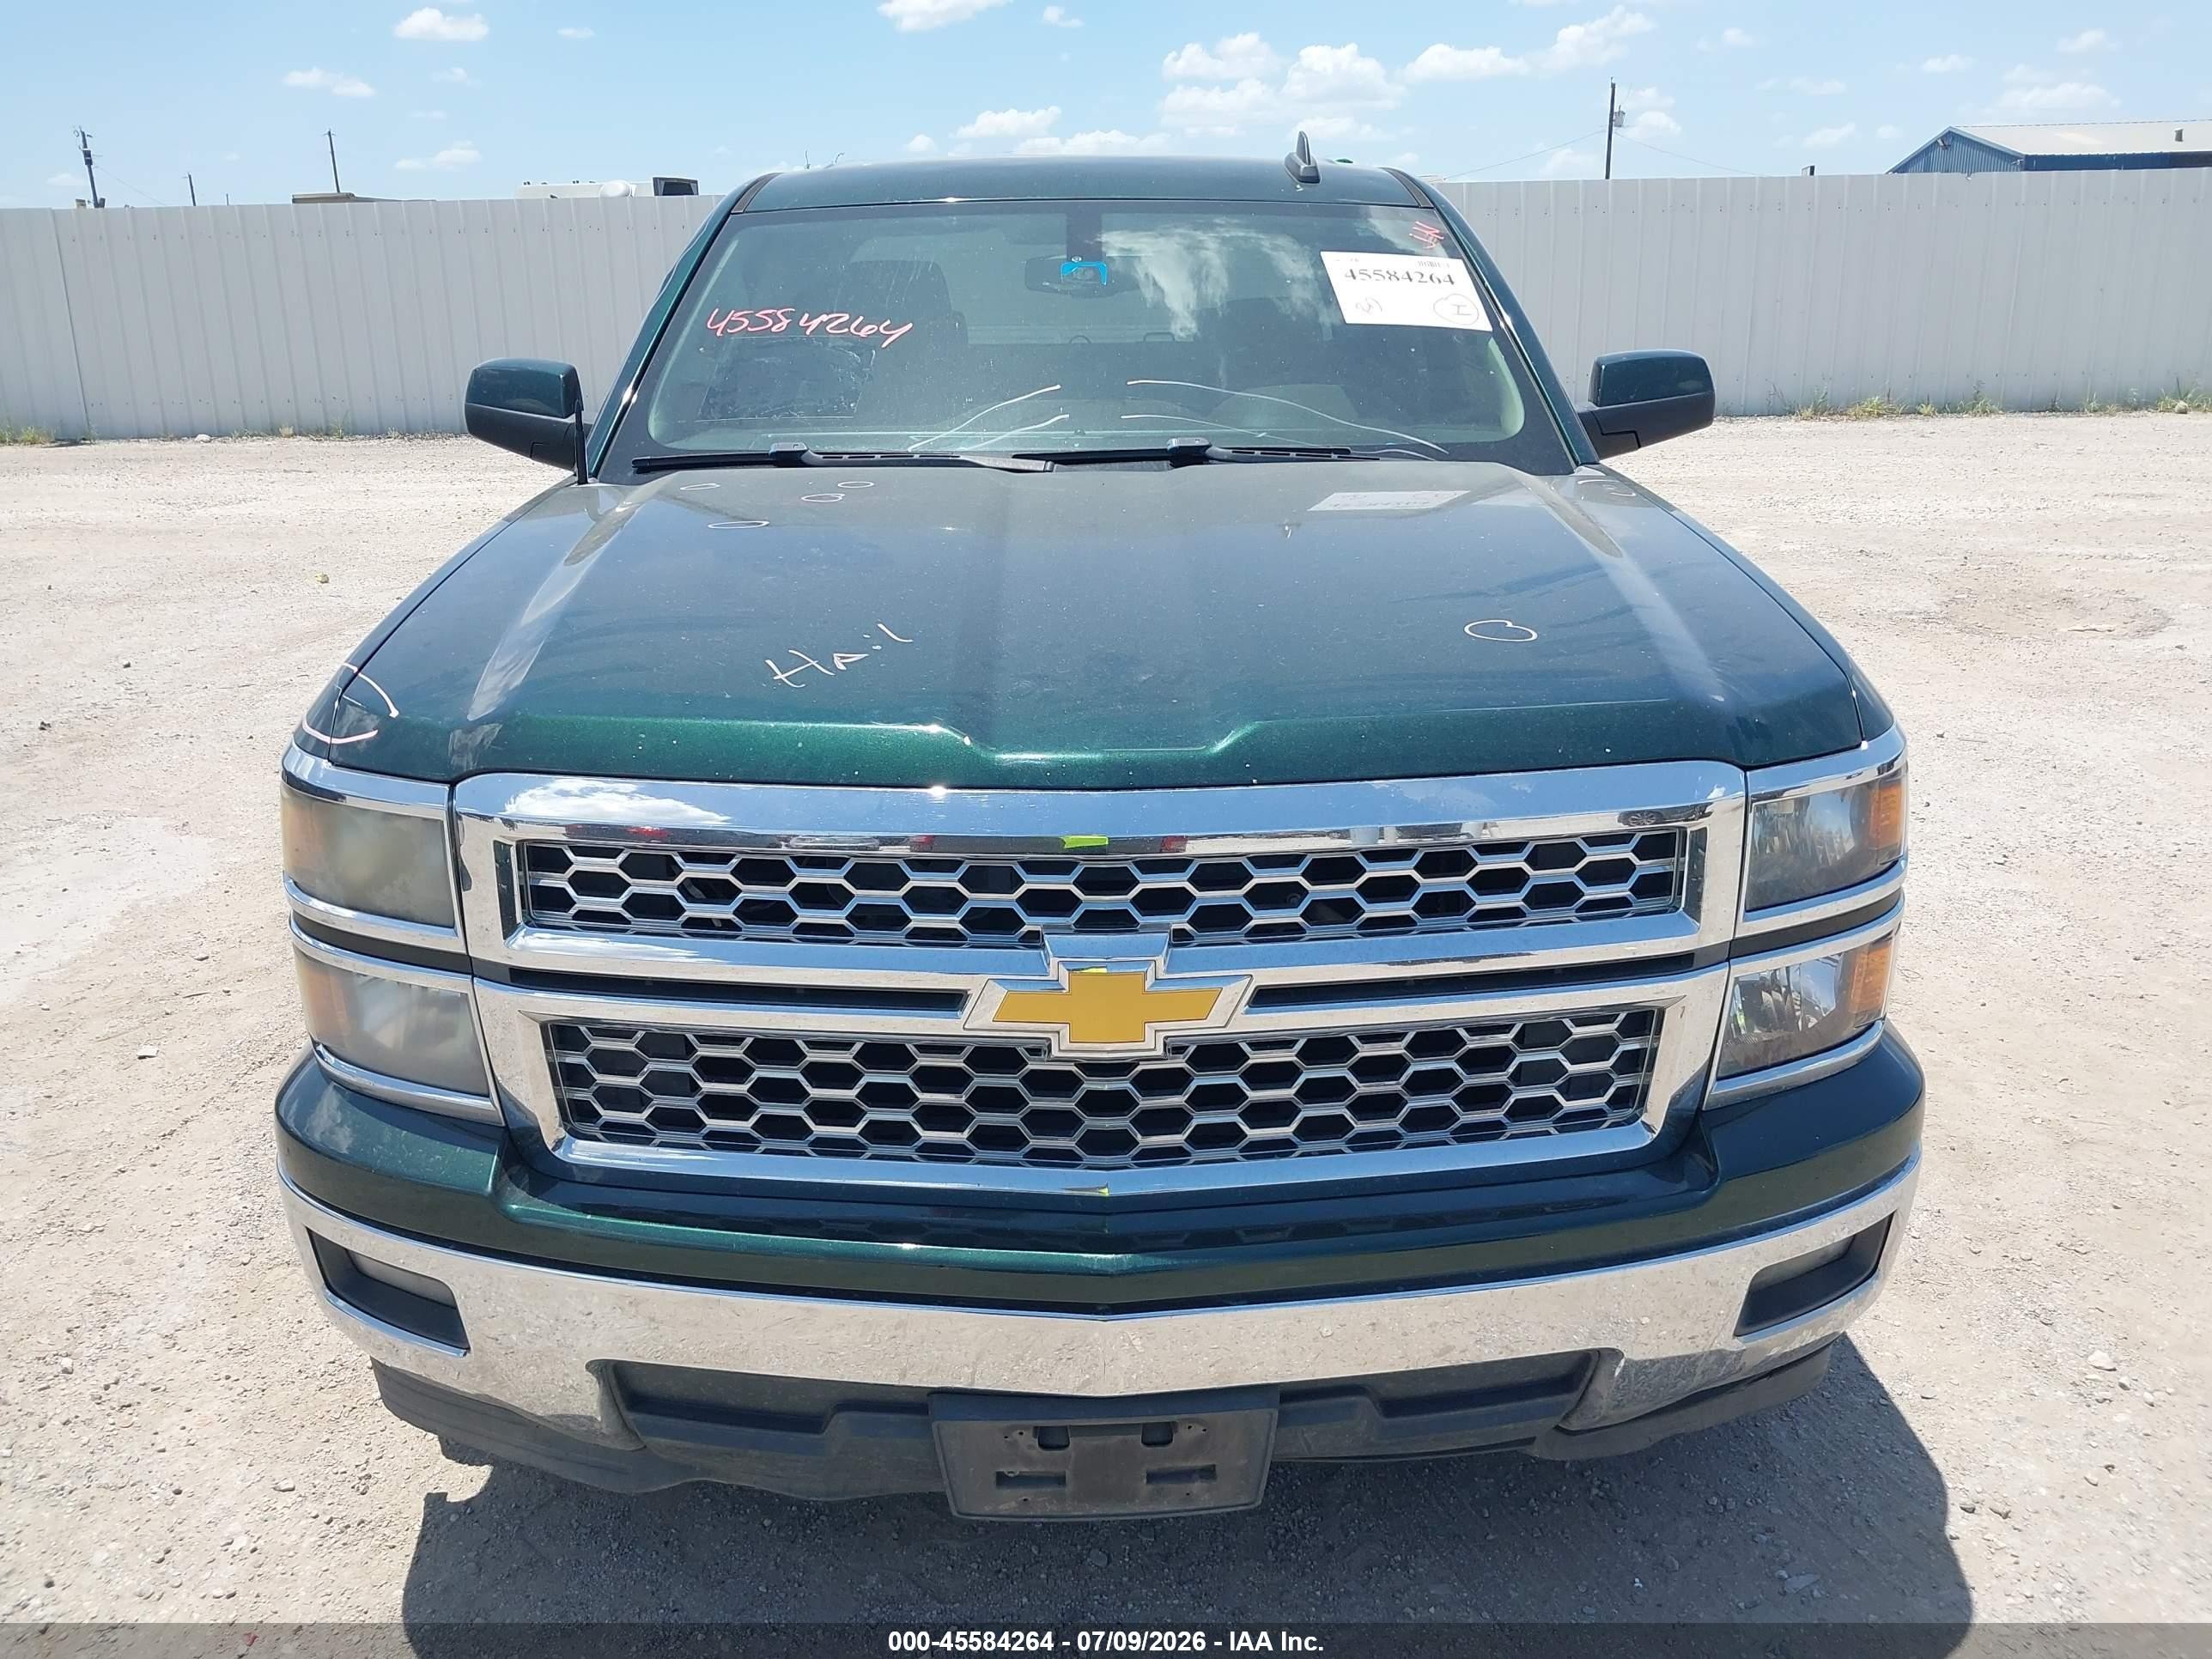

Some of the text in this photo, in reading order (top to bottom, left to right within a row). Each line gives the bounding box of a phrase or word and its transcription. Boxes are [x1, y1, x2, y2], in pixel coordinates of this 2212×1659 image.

[1345, 268, 1455, 286] 45584264
[706, 307, 914, 349] 45584264
[764, 623, 914, 689] Hail
